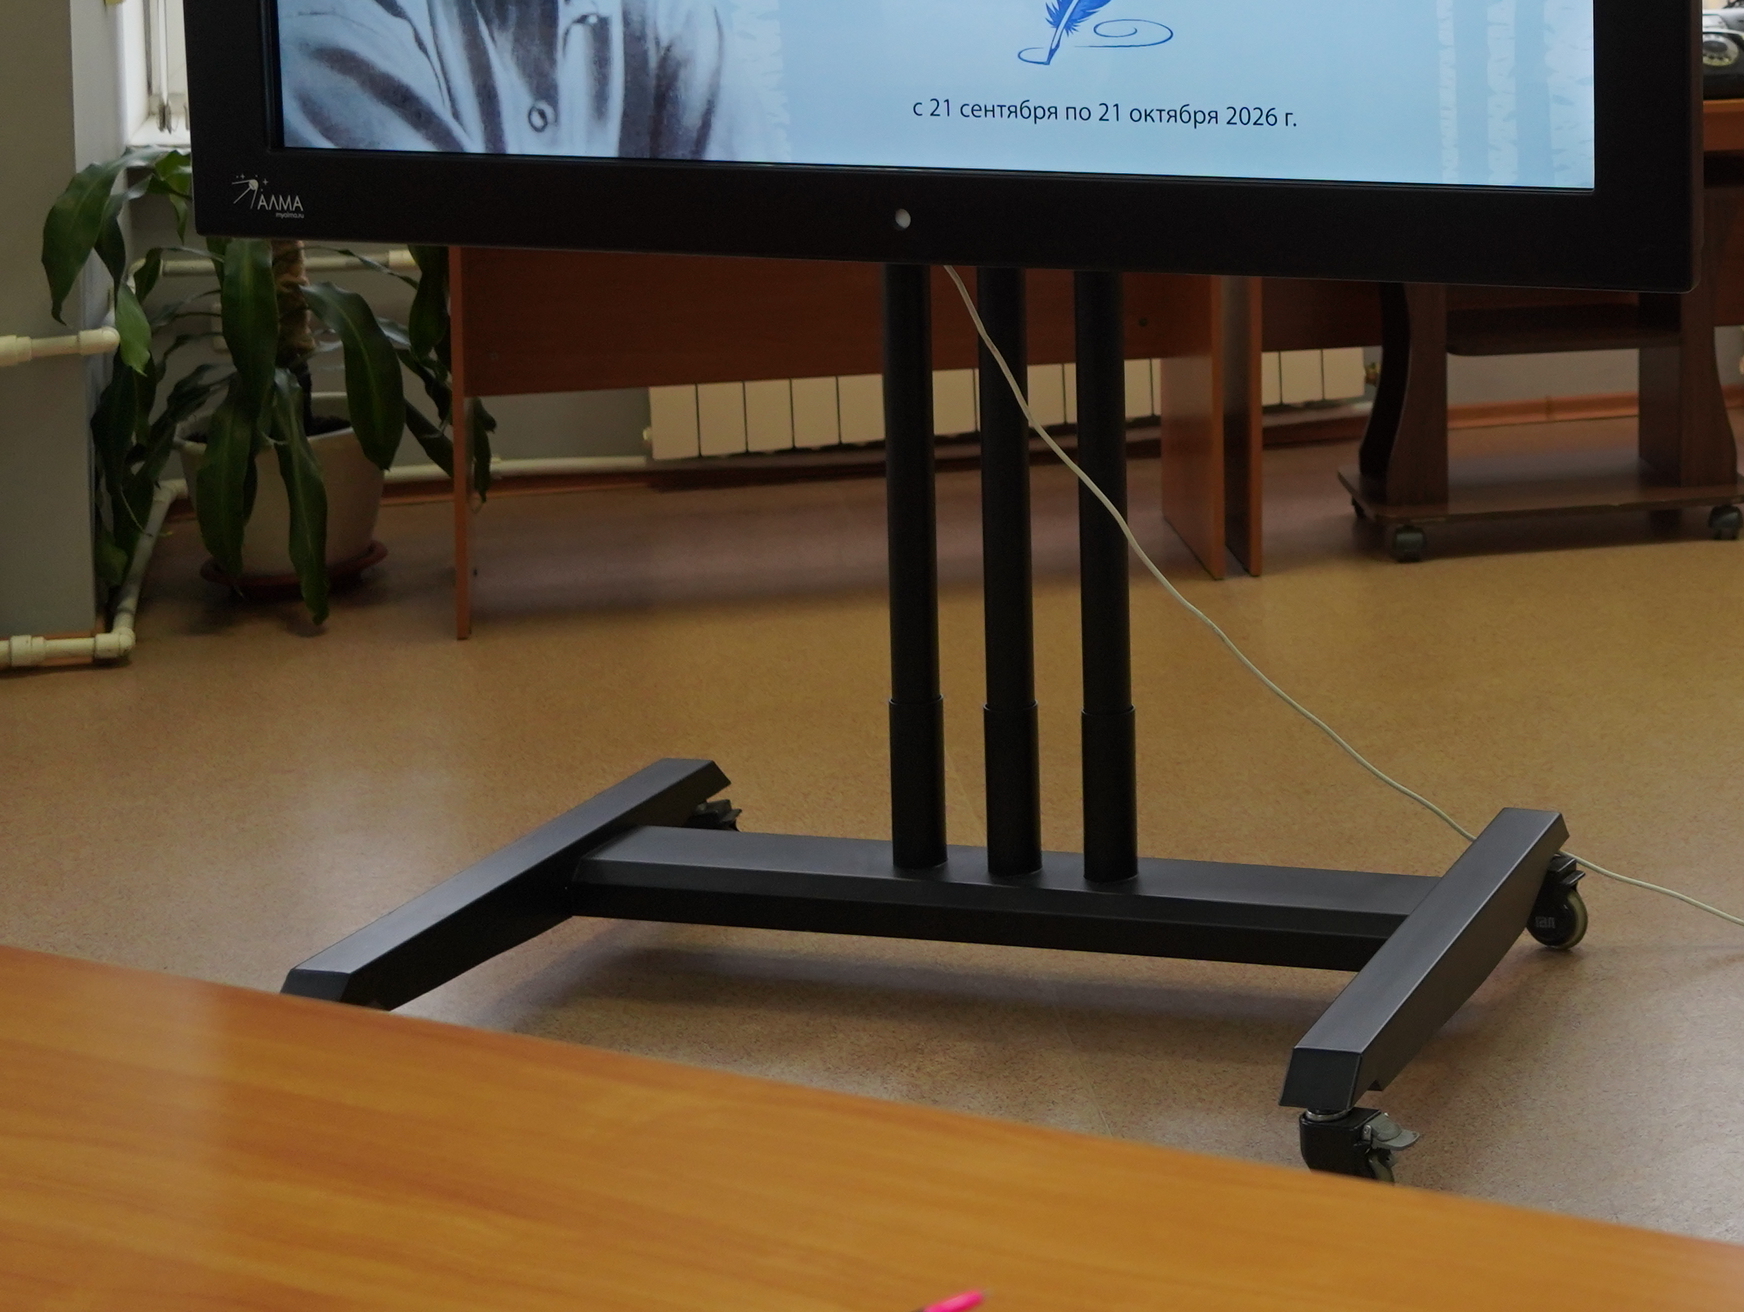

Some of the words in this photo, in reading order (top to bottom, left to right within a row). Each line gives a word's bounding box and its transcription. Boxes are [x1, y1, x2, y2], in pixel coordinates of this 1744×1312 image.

[912, 101, 923, 117] с
[929, 98, 951, 118] 21
[959, 99, 1058, 125] сентября
[1065, 106, 1092, 122] по
[1098, 102, 1120, 122] 21
[1129, 103, 1219, 129] октября
[1225, 106, 1278, 127] 2026
[1284, 111, 1297, 128] г.
